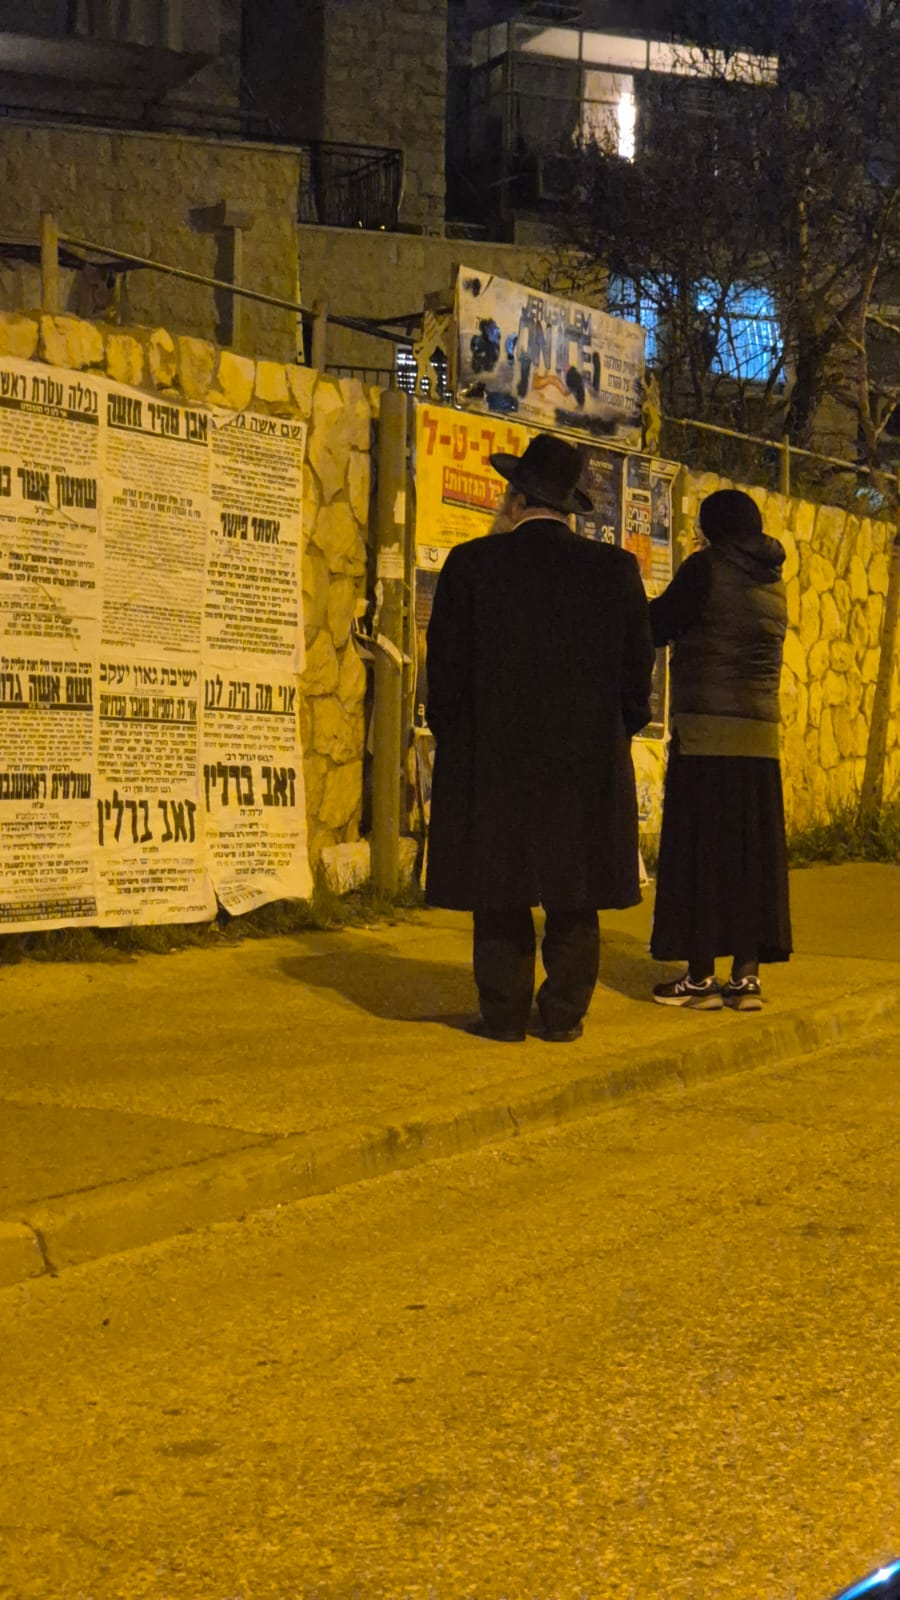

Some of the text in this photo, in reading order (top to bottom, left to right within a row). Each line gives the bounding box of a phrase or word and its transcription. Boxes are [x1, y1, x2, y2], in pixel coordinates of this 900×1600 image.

[32, 376, 64, 406] עטרת
[68, 382, 98, 414] נפלה
[108, 393, 208, 442] אבן מקיר תזעק
[250, 417, 276, 434] אשה
[280, 423, 301, 438] שם
[17, 467, 50, 502] אשר
[251, 517, 280, 544] אסתר
[28, 674, 60, 702] אשה
[66, 676, 93, 704] ושם
[100, 662, 198, 688] ישיבת גאון יעקב
[204, 673, 296, 712] אוי מה היה לנו
[51, 770, 92, 800] שולמית
[203, 761, 296, 814] זאב ברלין
[96, 789, 153, 848] ברלין
[158, 798, 197, 844] זאב
